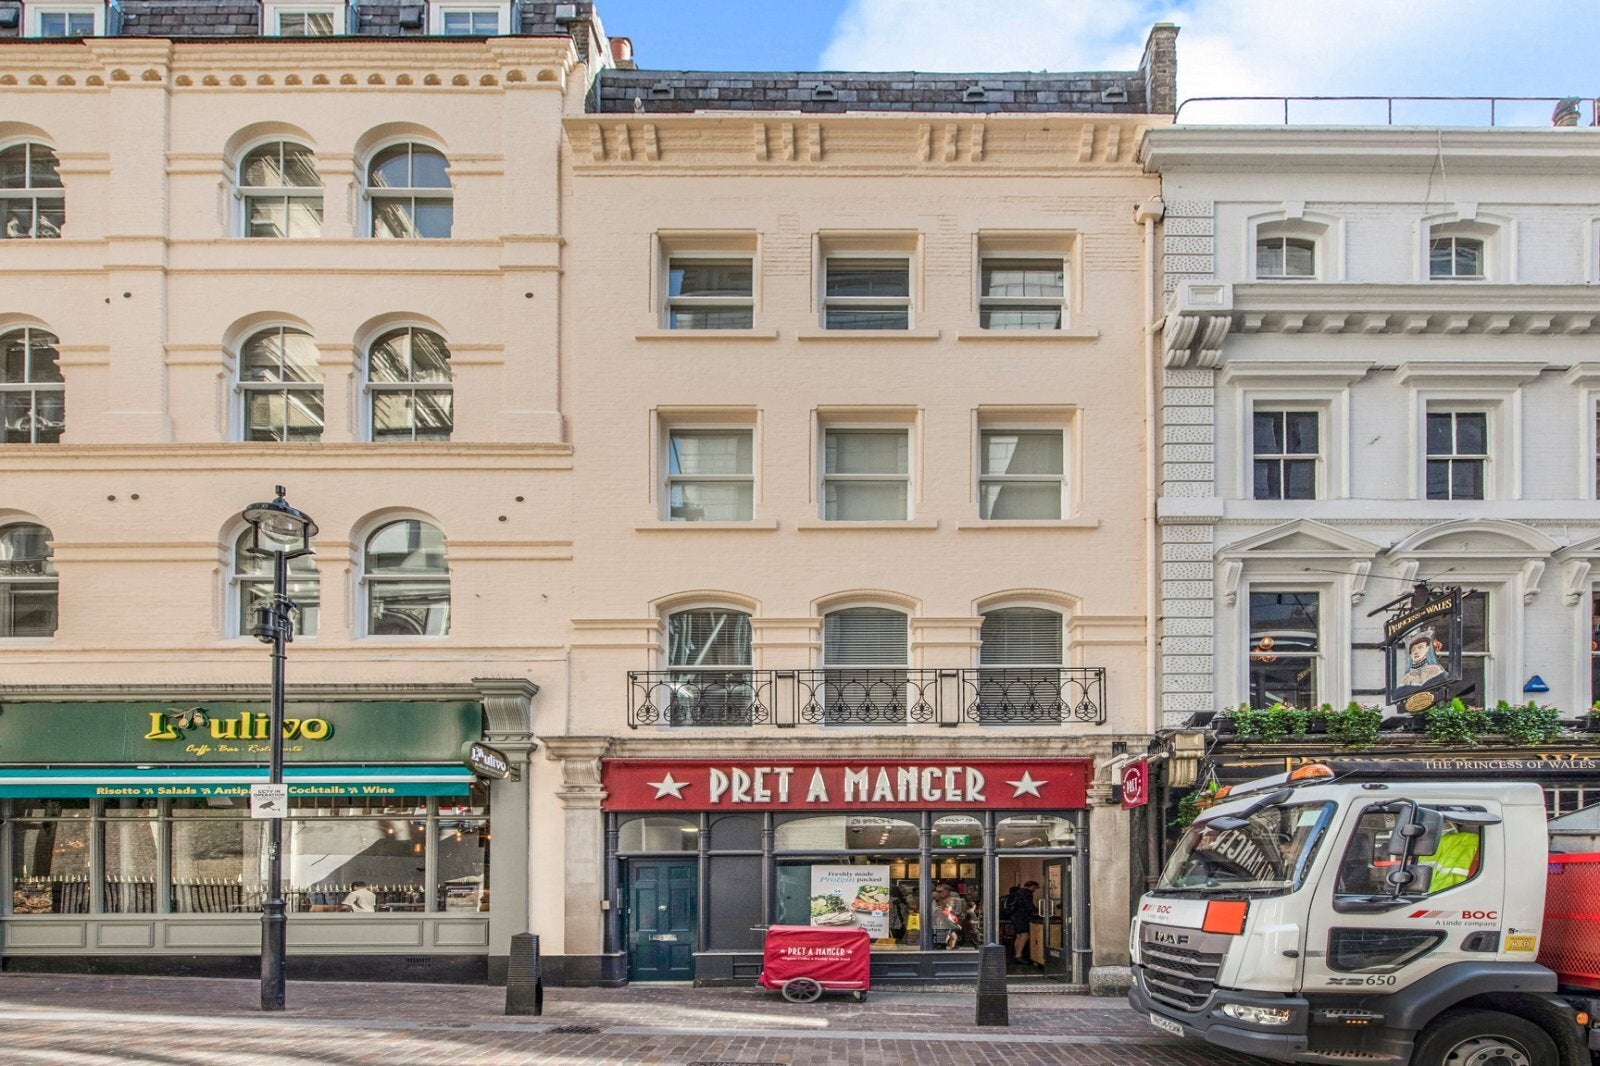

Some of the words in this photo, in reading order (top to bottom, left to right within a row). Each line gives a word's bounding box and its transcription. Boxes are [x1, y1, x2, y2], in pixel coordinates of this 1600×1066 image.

[1388, 613, 1421, 637] PRINCESS
[1425, 598, 1452, 614] WALES
[1424, 760, 1453, 769] THE
[1456, 760, 1523, 769] PRINCESS
[1526, 760, 1545, 769] OF
[1548, 760, 1596, 769] WALES
[709, 766, 795, 803] PRET
[805, 766, 830, 803] A
[844, 765, 987, 803] MANGER
[96, 786, 141, 795] Risotto
[157, 786, 197, 795] Salads
[288, 785, 346, 794] Cocktails
[362, 785, 395, 794] Wine
[1462, 910, 1498, 920] BOC
[1155, 931, 1190, 944] DAF
[787, 947, 807, 956] PRET
[807, 947, 813, 956] A
[815, 947, 846, 956] MANGER
